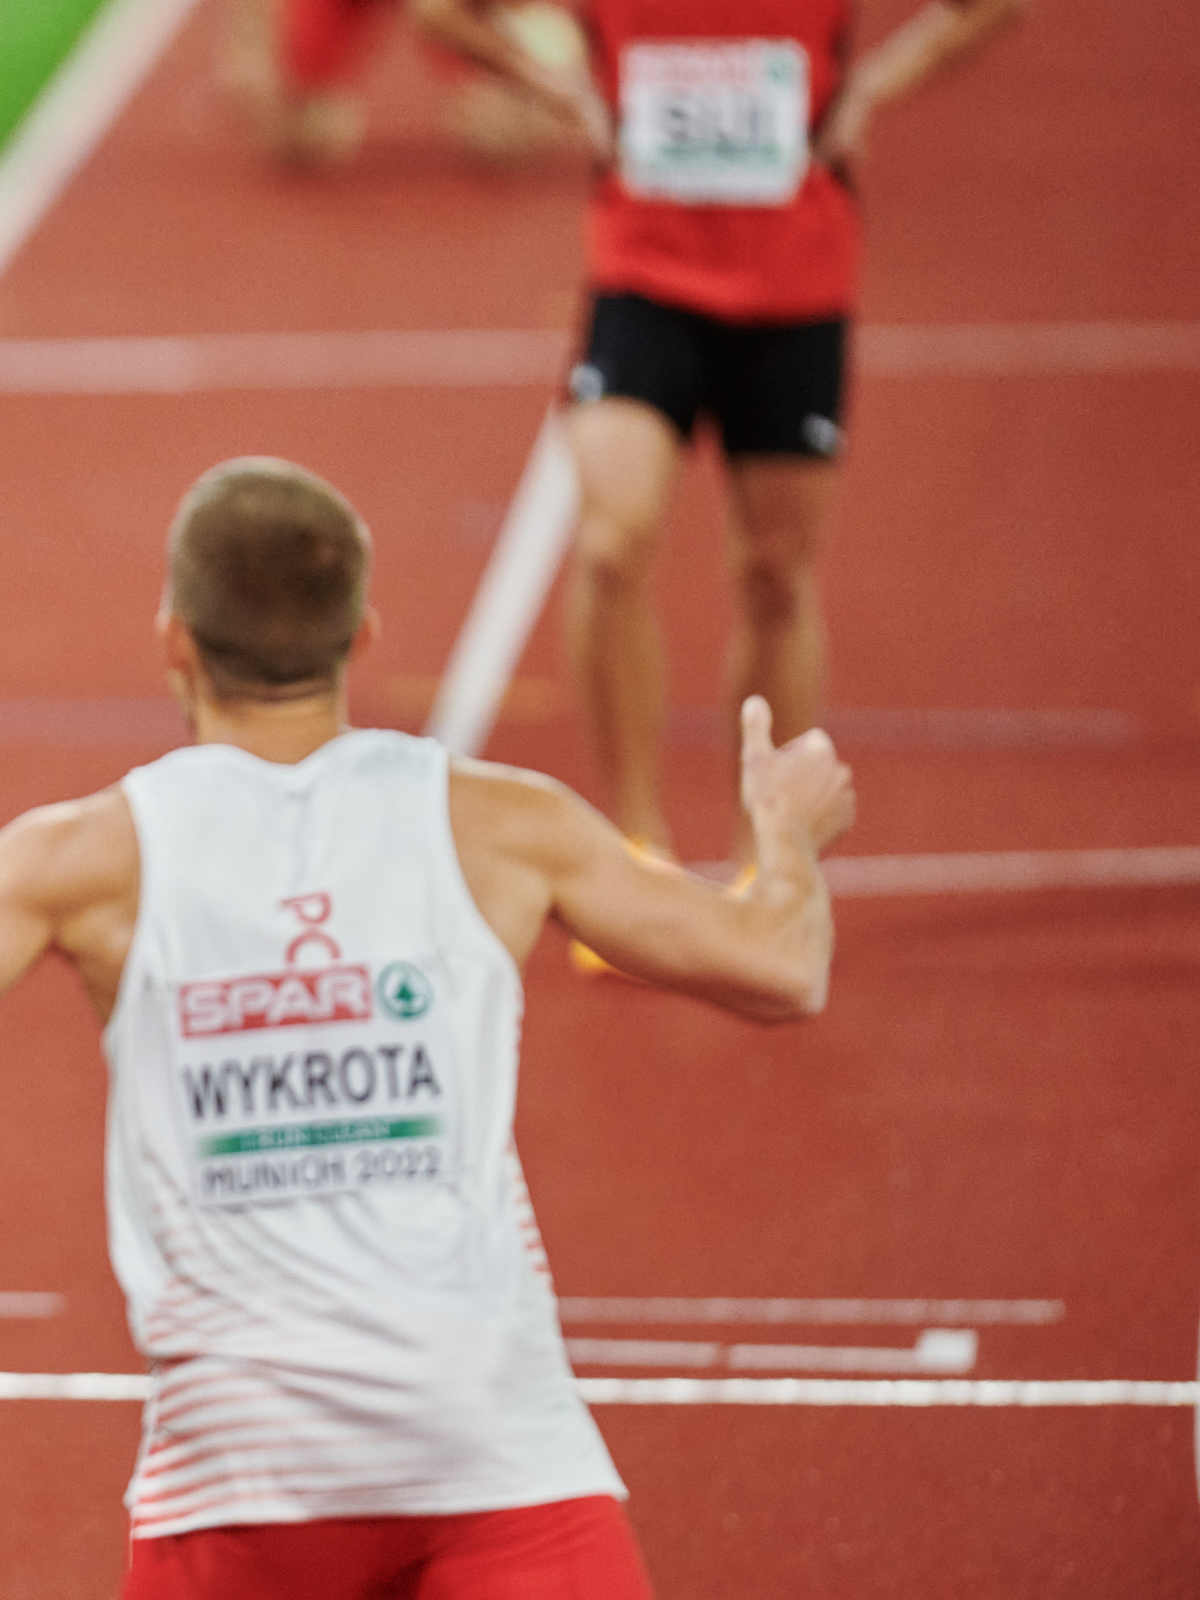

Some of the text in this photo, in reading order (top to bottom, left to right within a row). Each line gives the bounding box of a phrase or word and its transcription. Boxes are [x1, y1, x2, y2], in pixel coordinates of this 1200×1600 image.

[184, 967, 370, 1035] SPAR
[182, 1044, 442, 1120] WYKROTA
[204, 1145, 441, 1193] MUNICH 2022
